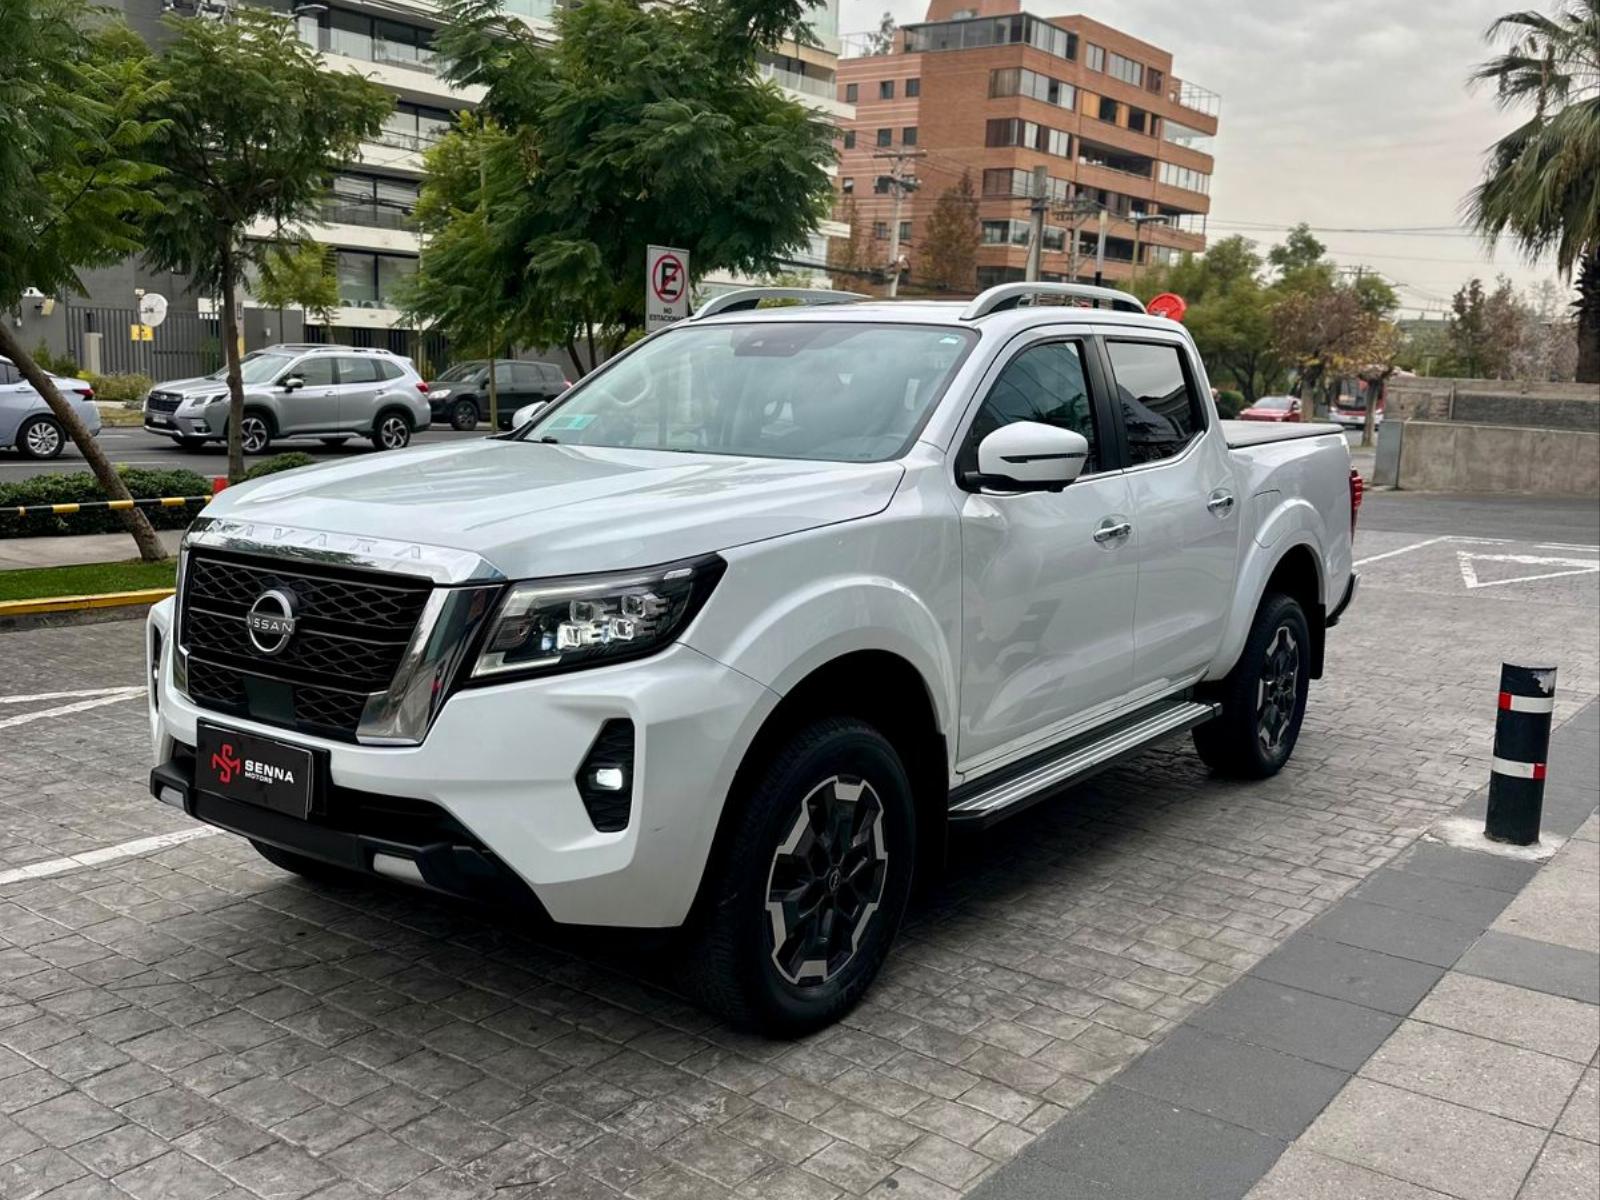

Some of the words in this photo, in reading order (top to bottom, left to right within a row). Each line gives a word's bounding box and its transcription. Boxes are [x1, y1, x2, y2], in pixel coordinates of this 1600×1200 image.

[206, 519, 421, 559] NAVARA
[247, 615, 293, 632] NISSAN
[245, 760, 294, 784] SENNA
[245, 772, 273, 784] MOTORS
